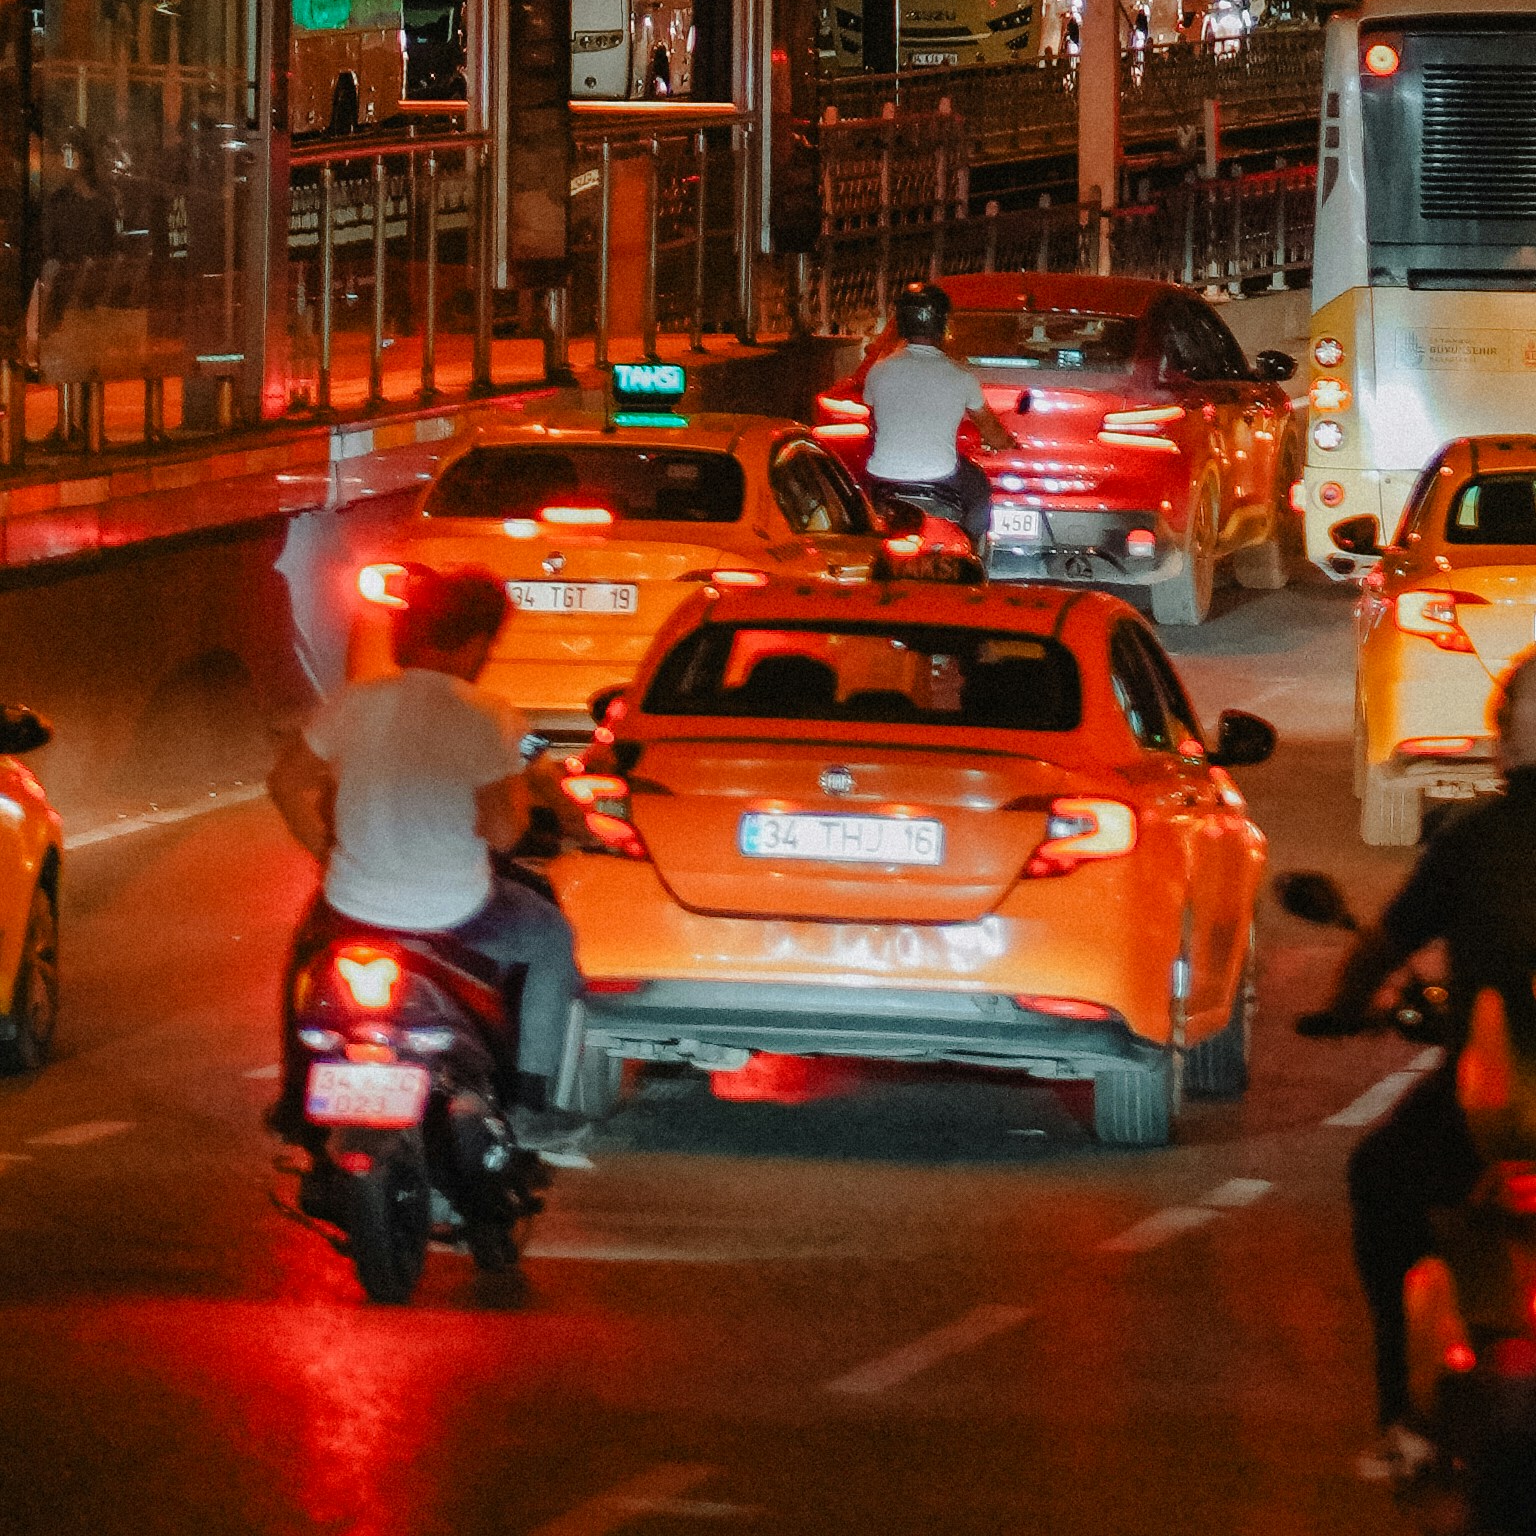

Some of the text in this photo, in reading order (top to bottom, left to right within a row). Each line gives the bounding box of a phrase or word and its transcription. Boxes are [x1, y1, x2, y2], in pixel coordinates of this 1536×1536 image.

[511, 586, 631, 610] 34 TGT 19
[764, 820, 933, 855] 34 THJ 16
